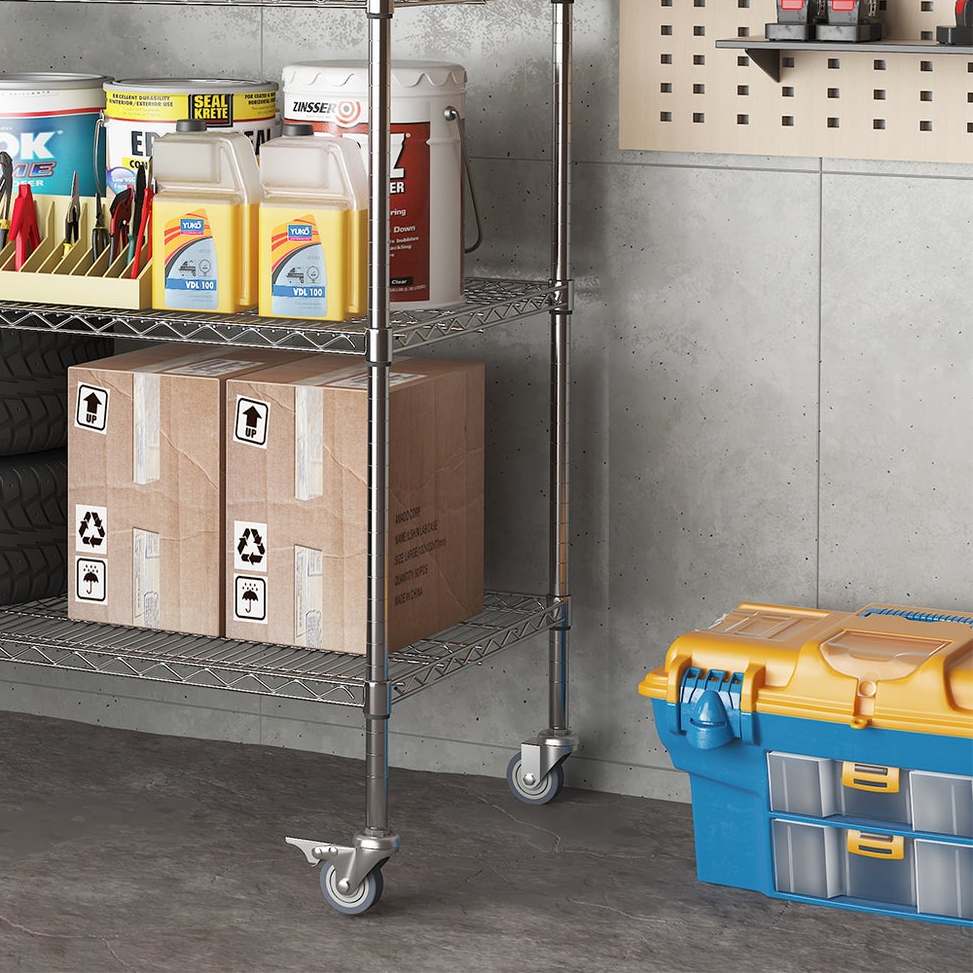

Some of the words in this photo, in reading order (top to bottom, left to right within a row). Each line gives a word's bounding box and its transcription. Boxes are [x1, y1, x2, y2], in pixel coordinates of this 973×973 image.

[194, 94, 228, 108] SEAL
[194, 107, 228, 119] KRETE
[292, 101, 337, 114] ZINSSER
[390, 181, 404, 194] ER
[390, 208, 406, 217] ring
[394, 225, 416, 233] Down
[185, 281, 200, 289] VDL
[202, 281, 214, 289] 100
[293, 287, 307, 296] VDL
[309, 288, 323, 297] 100
[85, 413, 97, 424] UP
[245, 428, 257, 439] UP
